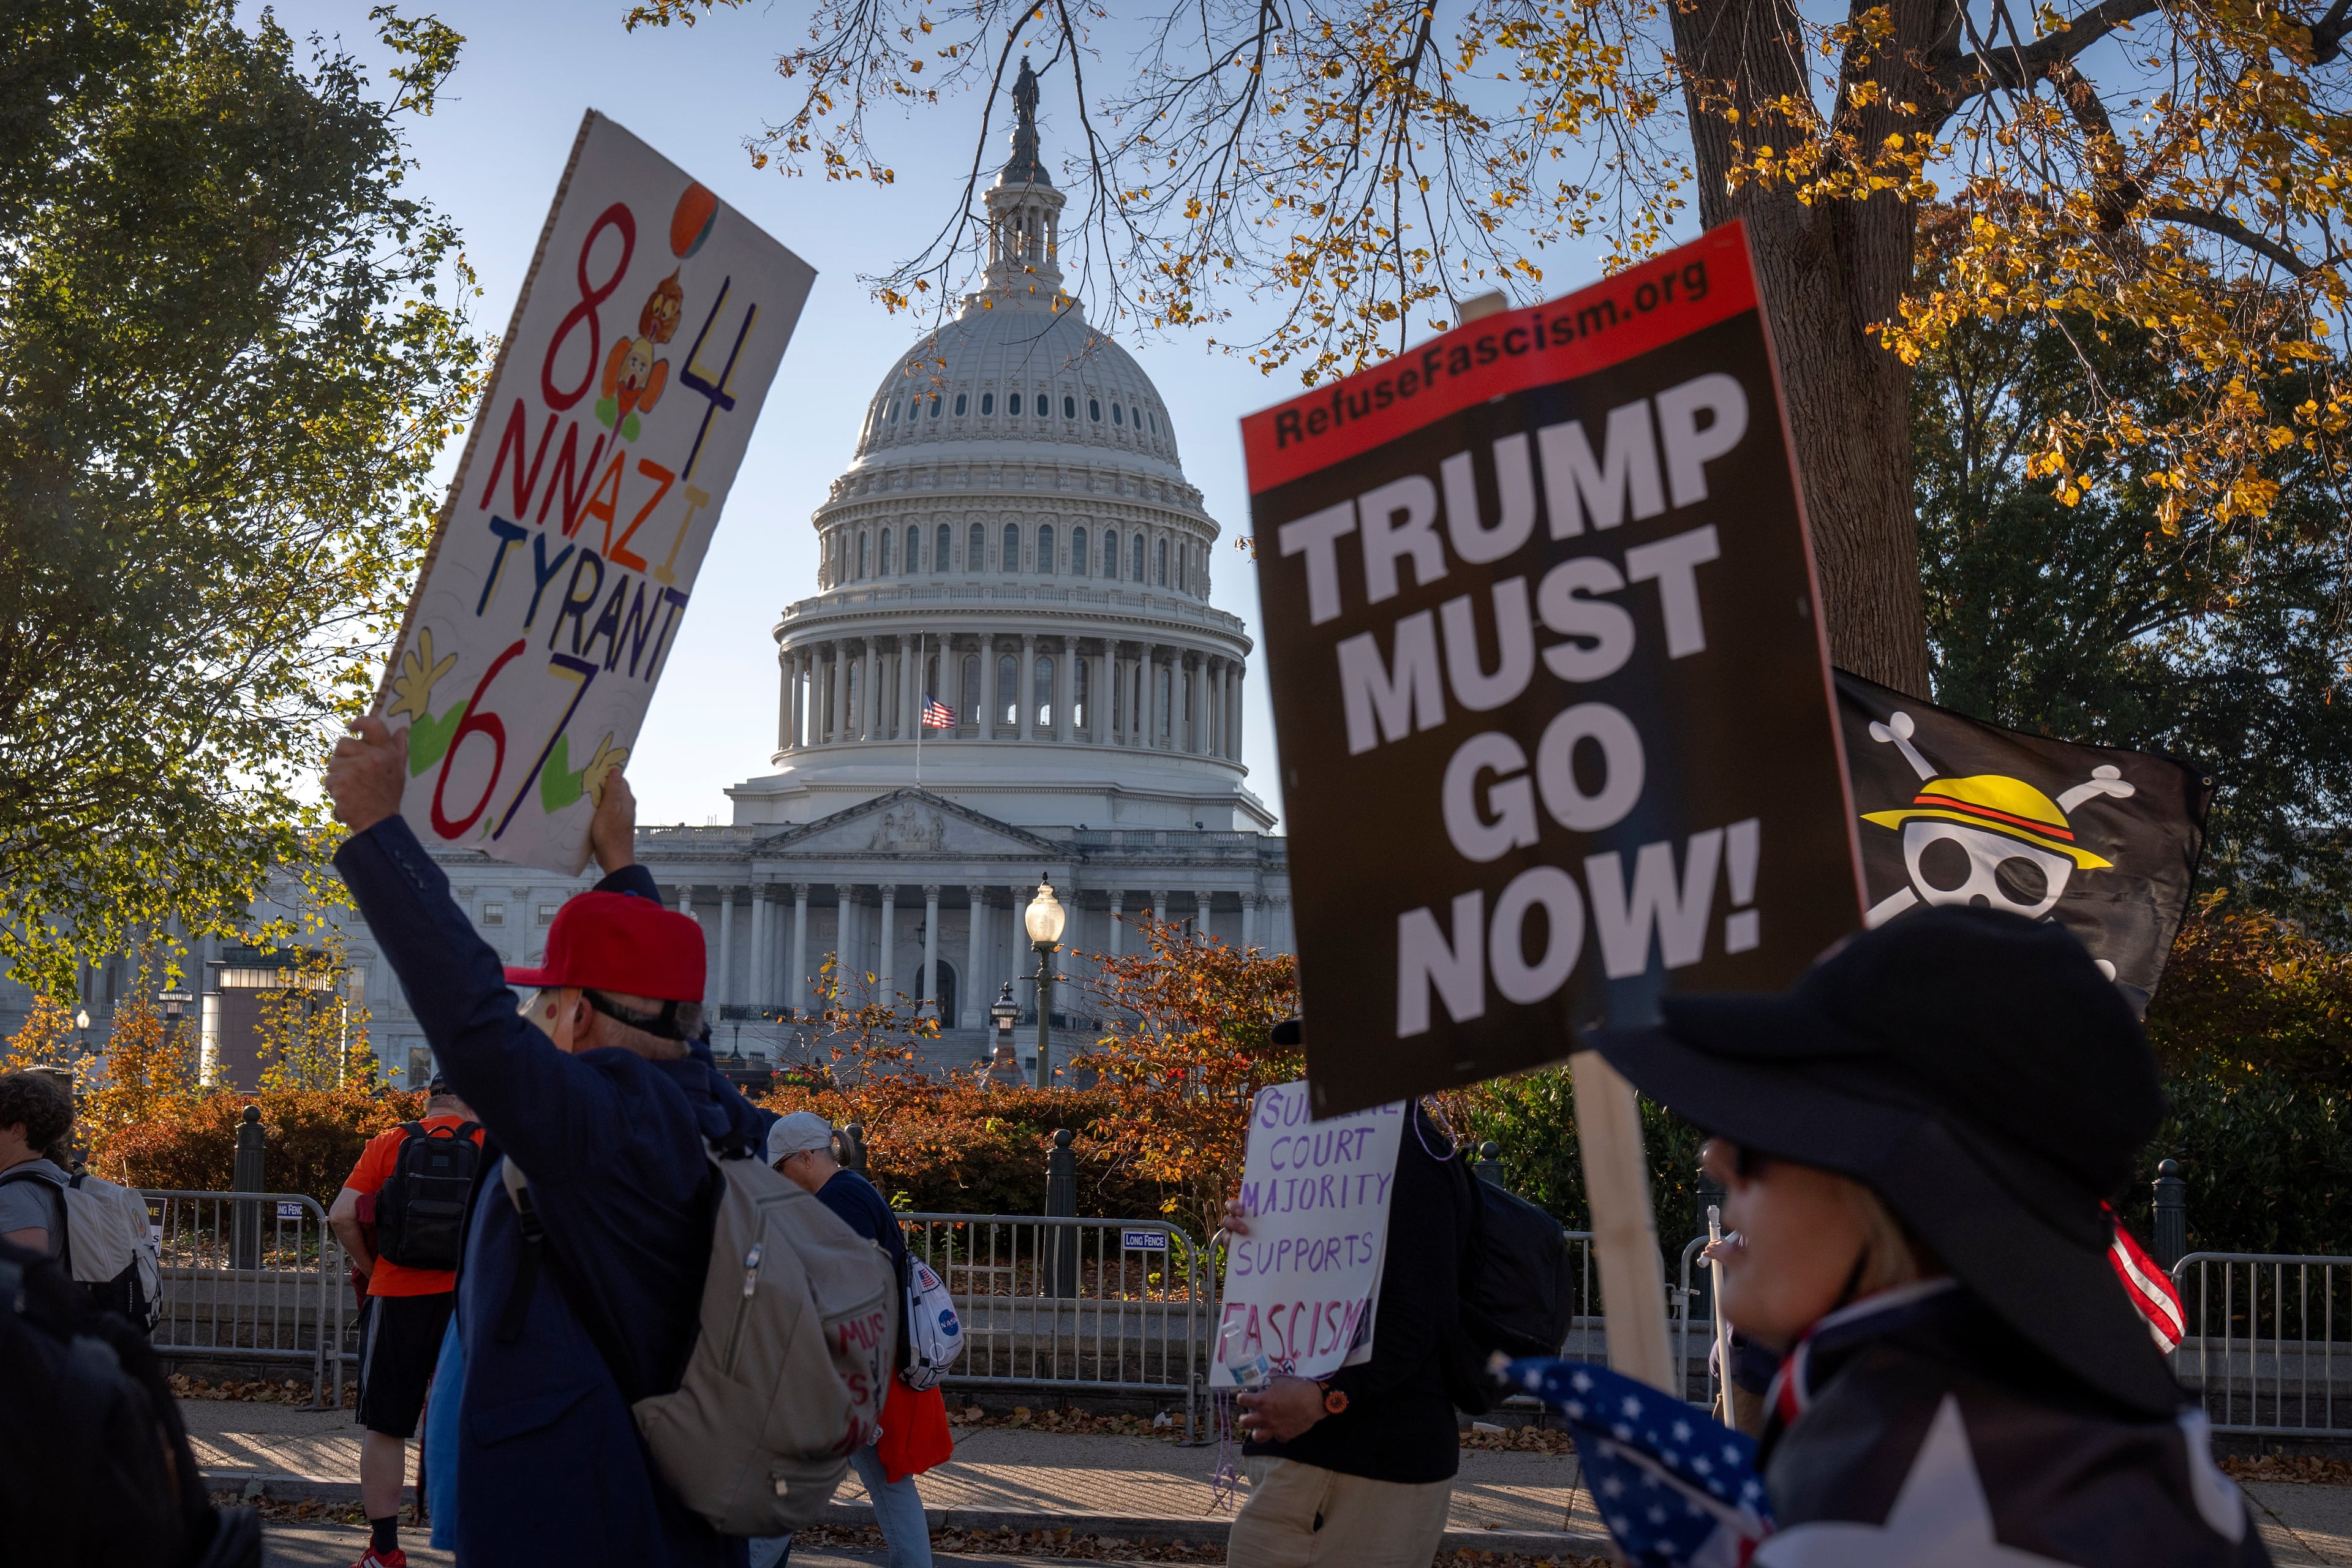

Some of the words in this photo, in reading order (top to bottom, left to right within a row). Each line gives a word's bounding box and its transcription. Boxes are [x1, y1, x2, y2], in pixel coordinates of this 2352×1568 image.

[1275, 260, 1710, 450] RefuseFascism.org
[1278, 372, 1749, 627] TRUMP
[475, 515, 689, 683] TYRANT
[1336, 524, 1721, 756] MUST
[1442, 702, 1646, 862] GO
[1396, 817, 1760, 1039] NOW!
[1242, 1171, 1393, 1218] MAJORITY
[1270, 1128, 1376, 1171] COURT
[1125, 1234, 1144, 1246] LONG
[1144, 1234, 1164, 1246] FENCE
[1235, 1231, 1373, 1276] SUPPORTS
[1217, 1298, 1365, 1365] FASCISM
